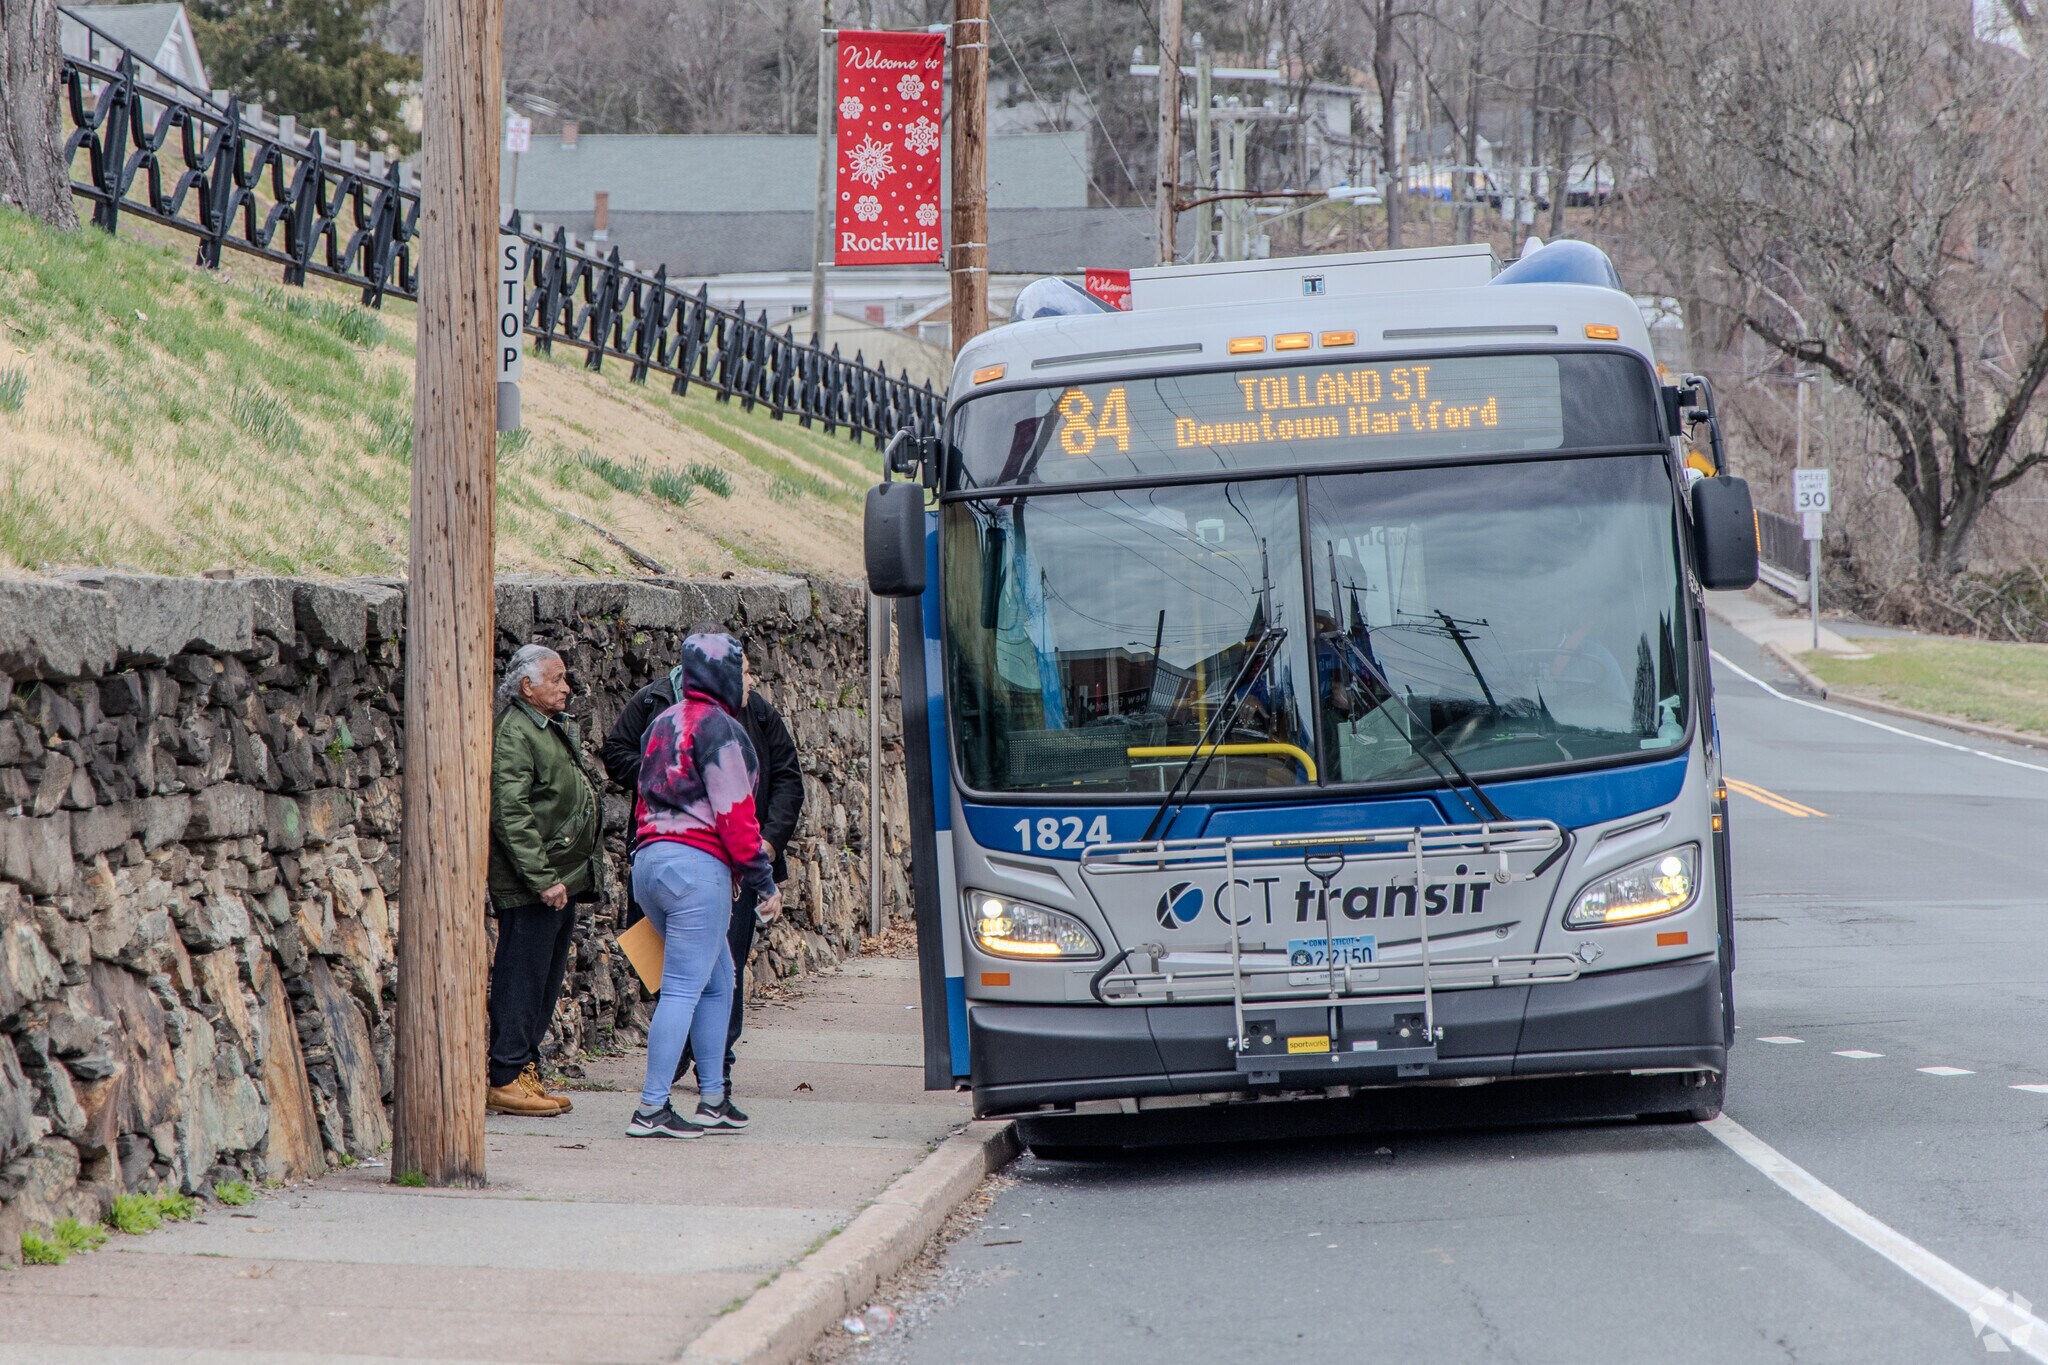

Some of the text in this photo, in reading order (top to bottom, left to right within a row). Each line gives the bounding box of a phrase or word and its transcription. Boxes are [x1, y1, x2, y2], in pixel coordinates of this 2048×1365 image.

[843, 45, 941, 70] Welcome to
[841, 231, 940, 252] Rockville
[500, 245, 519, 373] STOP
[1238, 365, 1431, 412] TOLLAND ST
[1058, 386, 1131, 455] 84
[1175, 396, 1499, 448] Downtown Hartford
[1799, 491, 1826, 507] 30
[1013, 815, 1112, 852] 1824
[1213, 863, 1491, 927] CT transit
[1309, 937, 1354, 947] CONNCTICUT
[1289, 1040, 1328, 1049] sportworks
